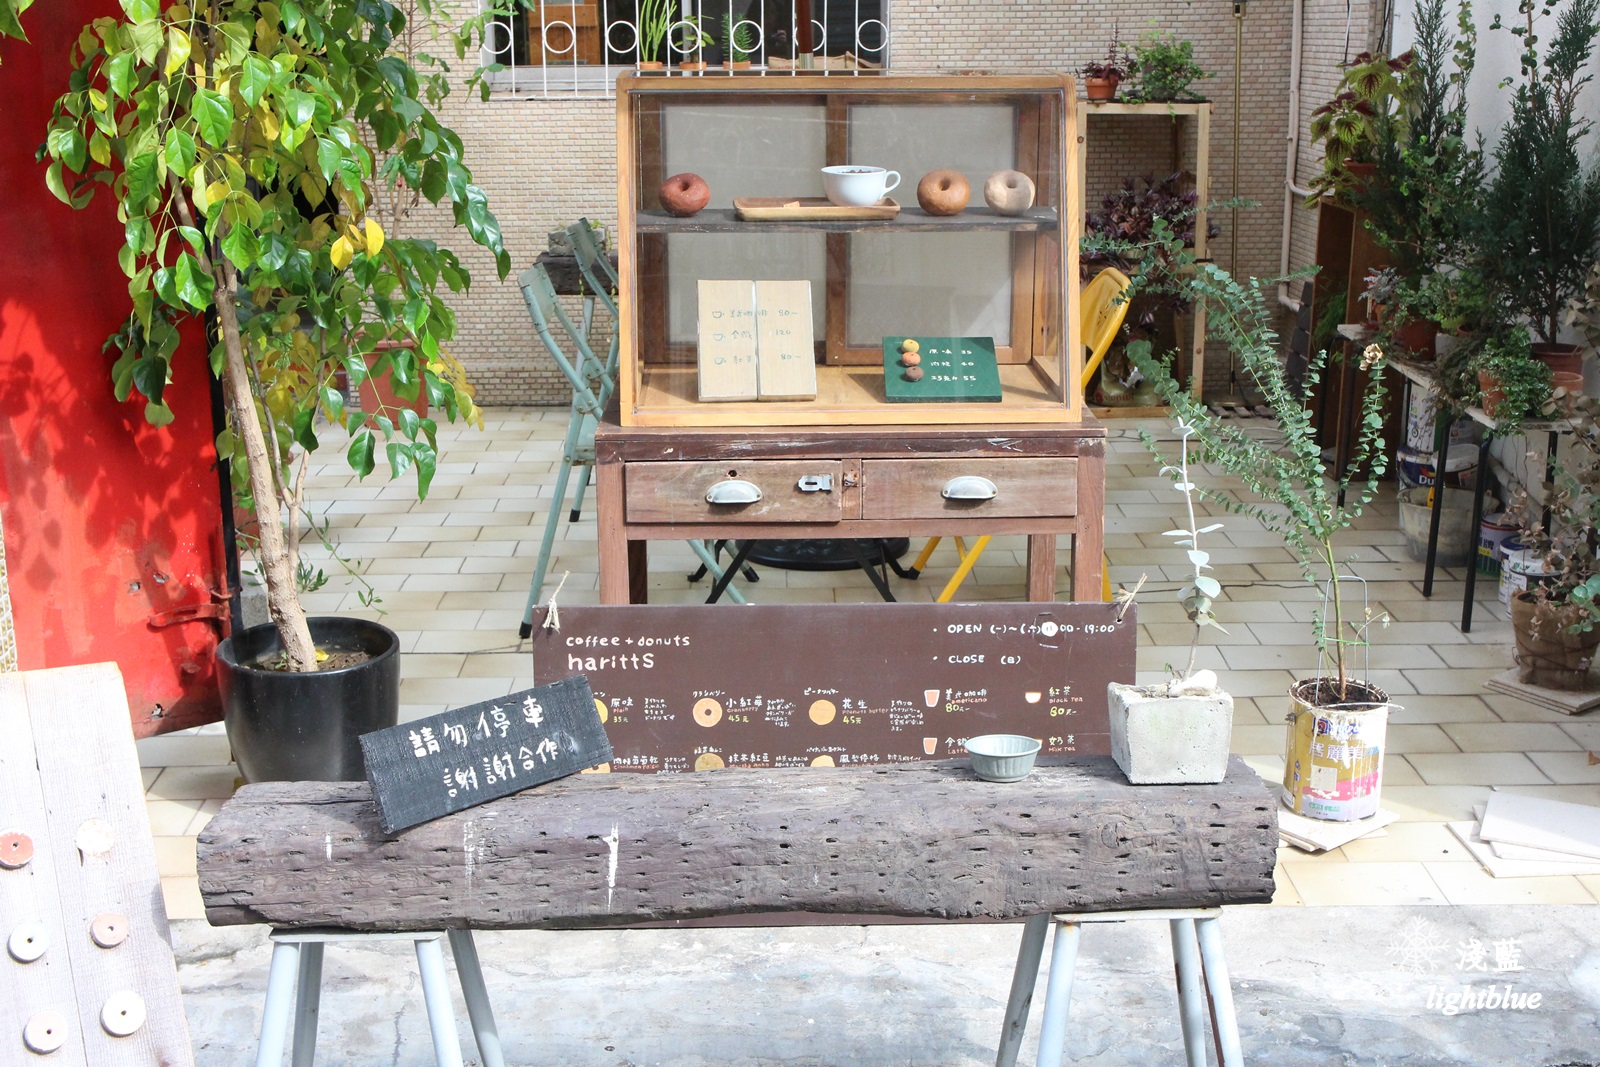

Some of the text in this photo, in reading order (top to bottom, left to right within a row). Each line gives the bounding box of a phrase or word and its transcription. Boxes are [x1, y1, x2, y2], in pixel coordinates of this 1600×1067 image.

[947, 624, 982, 633] OPEN
[566, 635, 690, 647] coffee + donuts
[948, 655, 985, 664] CLOSE
[1049, 686, 1071, 697] 紅茶
[611, 697, 634, 707] 原味
[842, 698, 868, 709] 花生
[408, 695, 544, 758] 請勿停車
[1049, 734, 1075, 746] 奶茶
[443, 738, 559, 798] 謝謝合作
